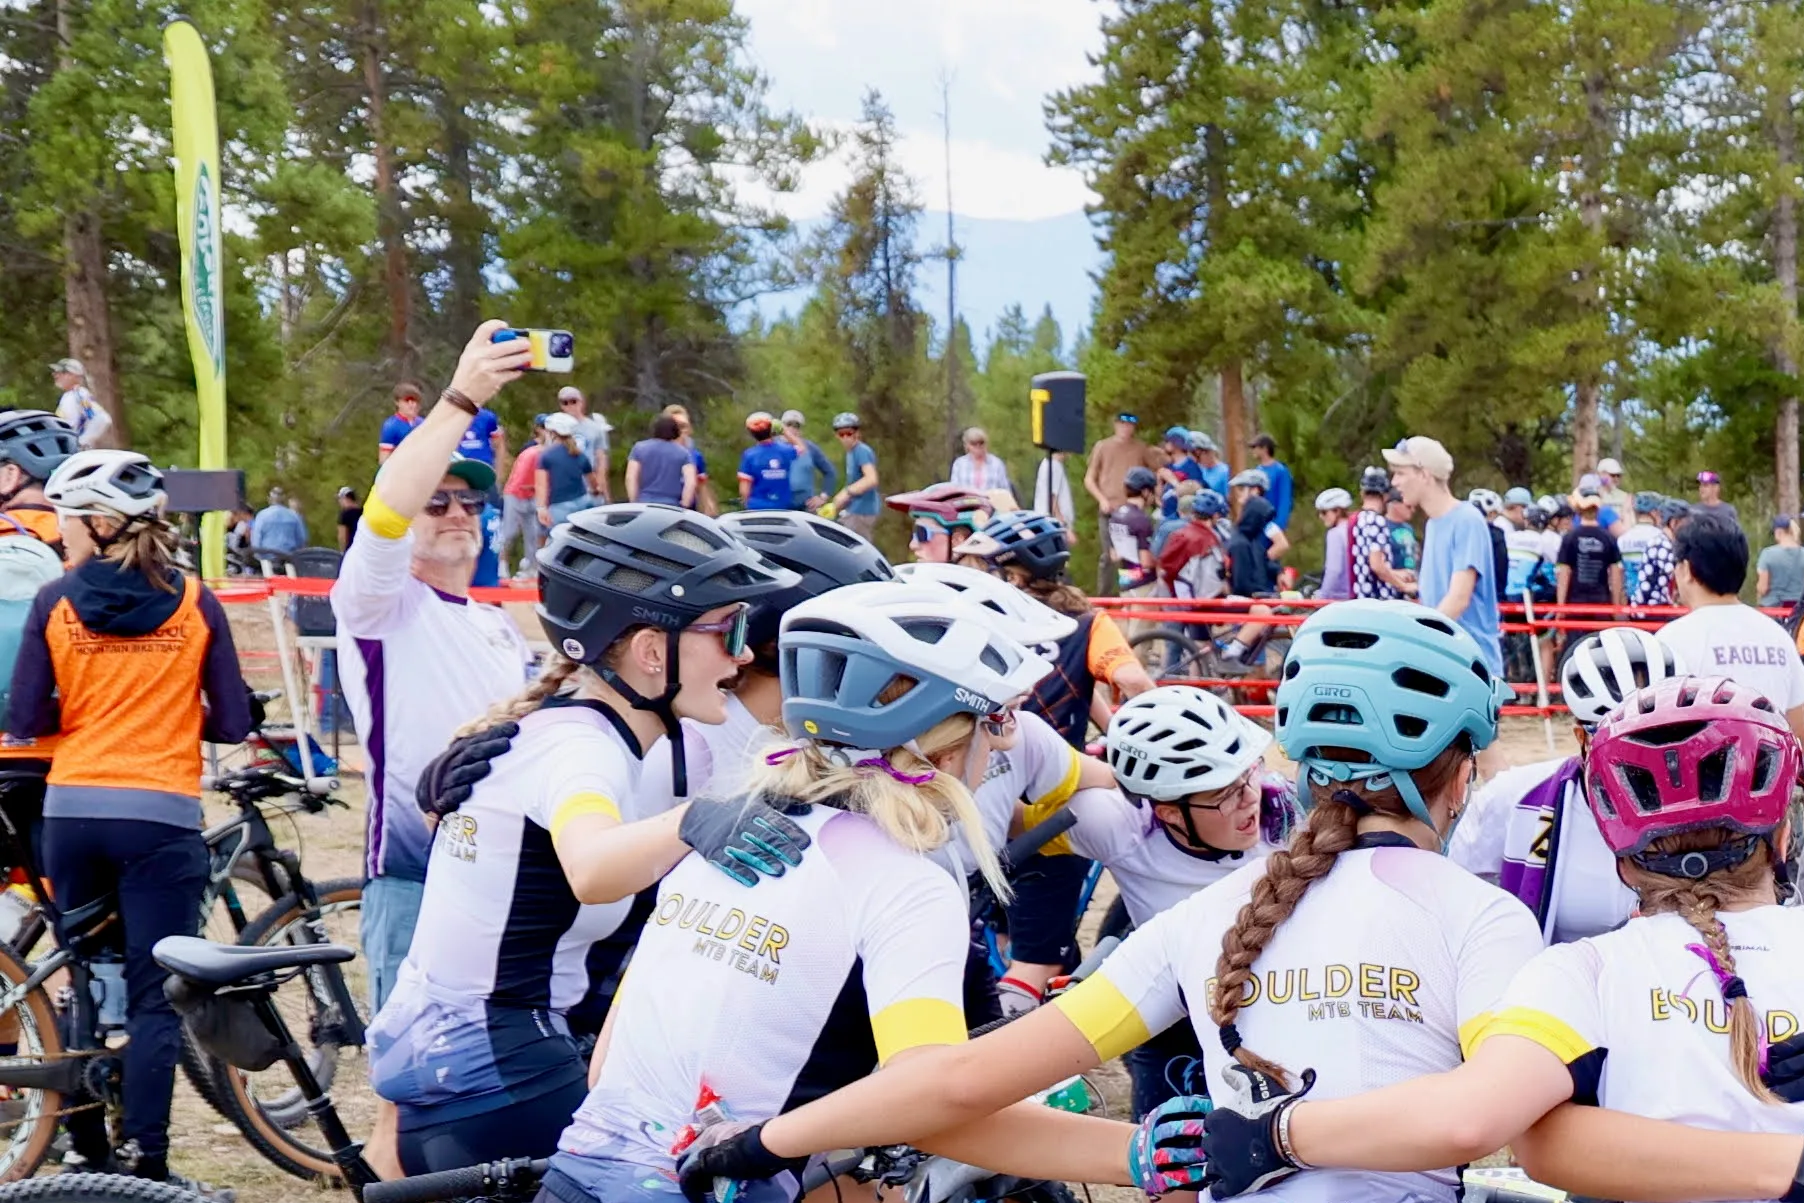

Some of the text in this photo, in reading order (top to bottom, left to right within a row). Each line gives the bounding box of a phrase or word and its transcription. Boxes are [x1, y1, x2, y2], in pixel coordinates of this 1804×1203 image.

[632, 605, 681, 627] SMITH
[1712, 644, 1787, 666] EAGLES
[954, 687, 991, 713] SMITH
[1313, 685, 1352, 698] GIRO
[1119, 740, 1149, 760] GIRO
[647, 892, 790, 965] OULDER
[692, 940, 780, 986] MTB TEAM
[1308, 1000, 1424, 1024] MTB TEAM
